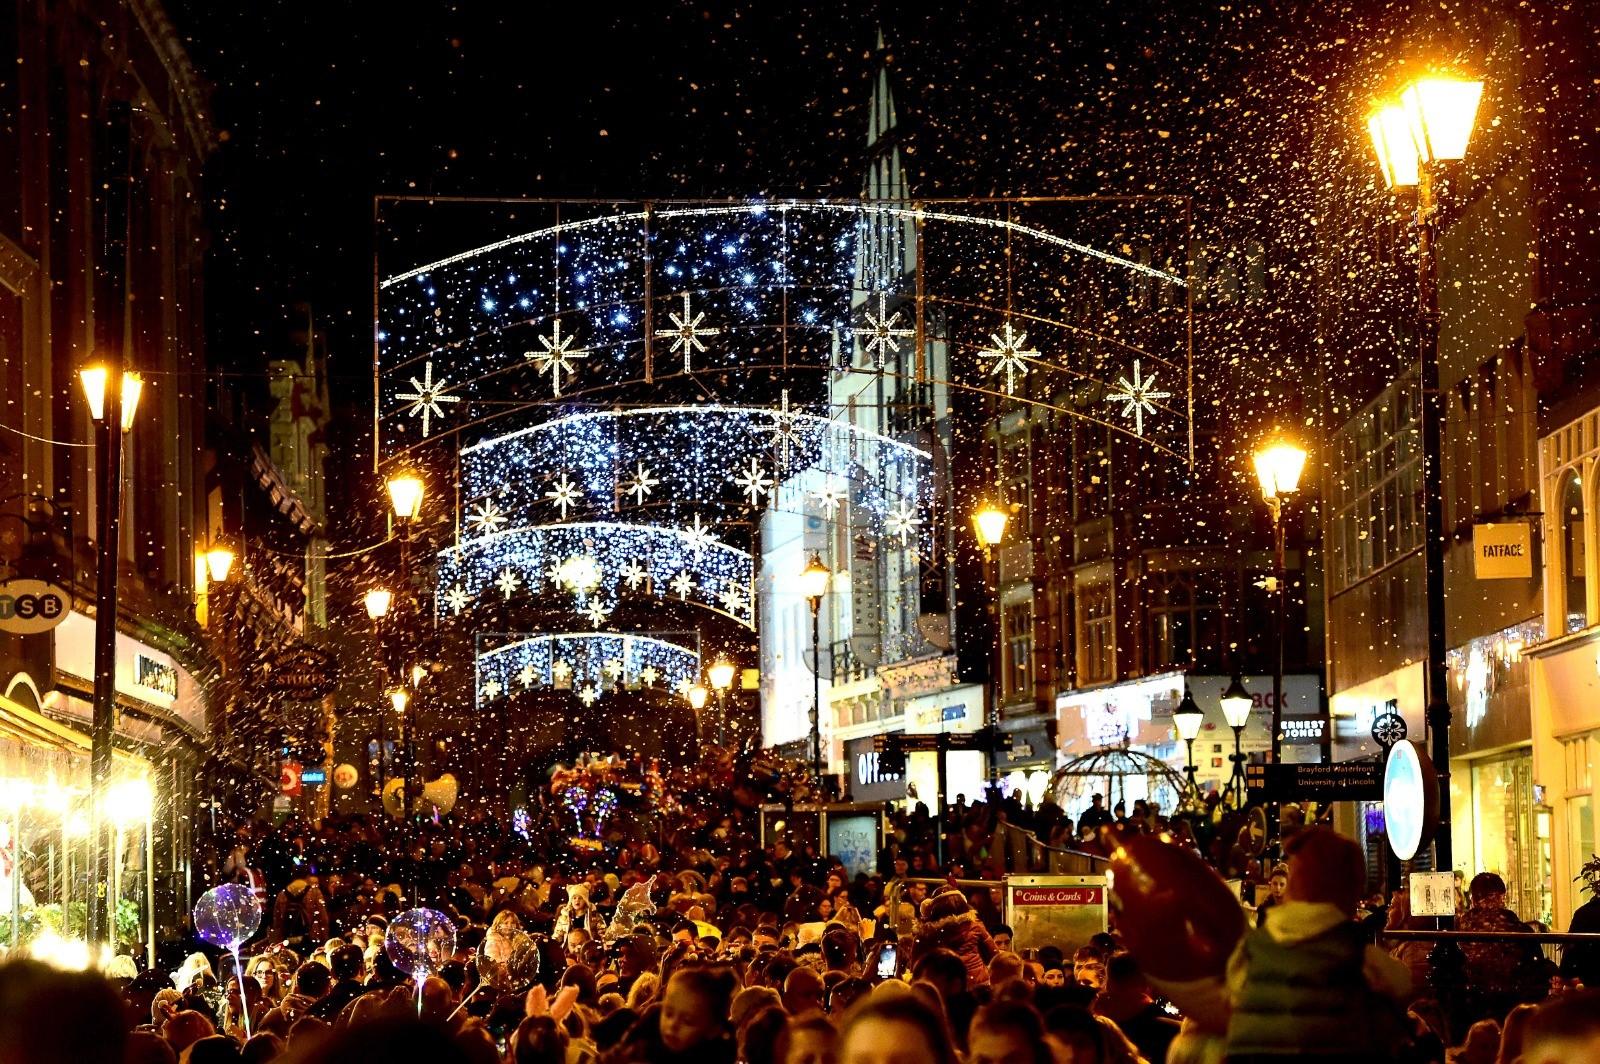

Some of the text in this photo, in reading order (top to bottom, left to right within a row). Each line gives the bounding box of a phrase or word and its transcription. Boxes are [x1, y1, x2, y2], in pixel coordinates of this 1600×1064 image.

[1483, 543, 1523, 557] FATFACE
[0, 599, 56, 614] TSB
[1280, 720, 1325, 730] ERNEST
[1285, 729, 1322, 738] JONES
[1297, 765, 1375, 775] Brayford Waterfront
[1298, 778, 1336, 787] University
[1338, 778, 1346, 786] of
[1022, 889, 1081, 902] Coins & Cards
